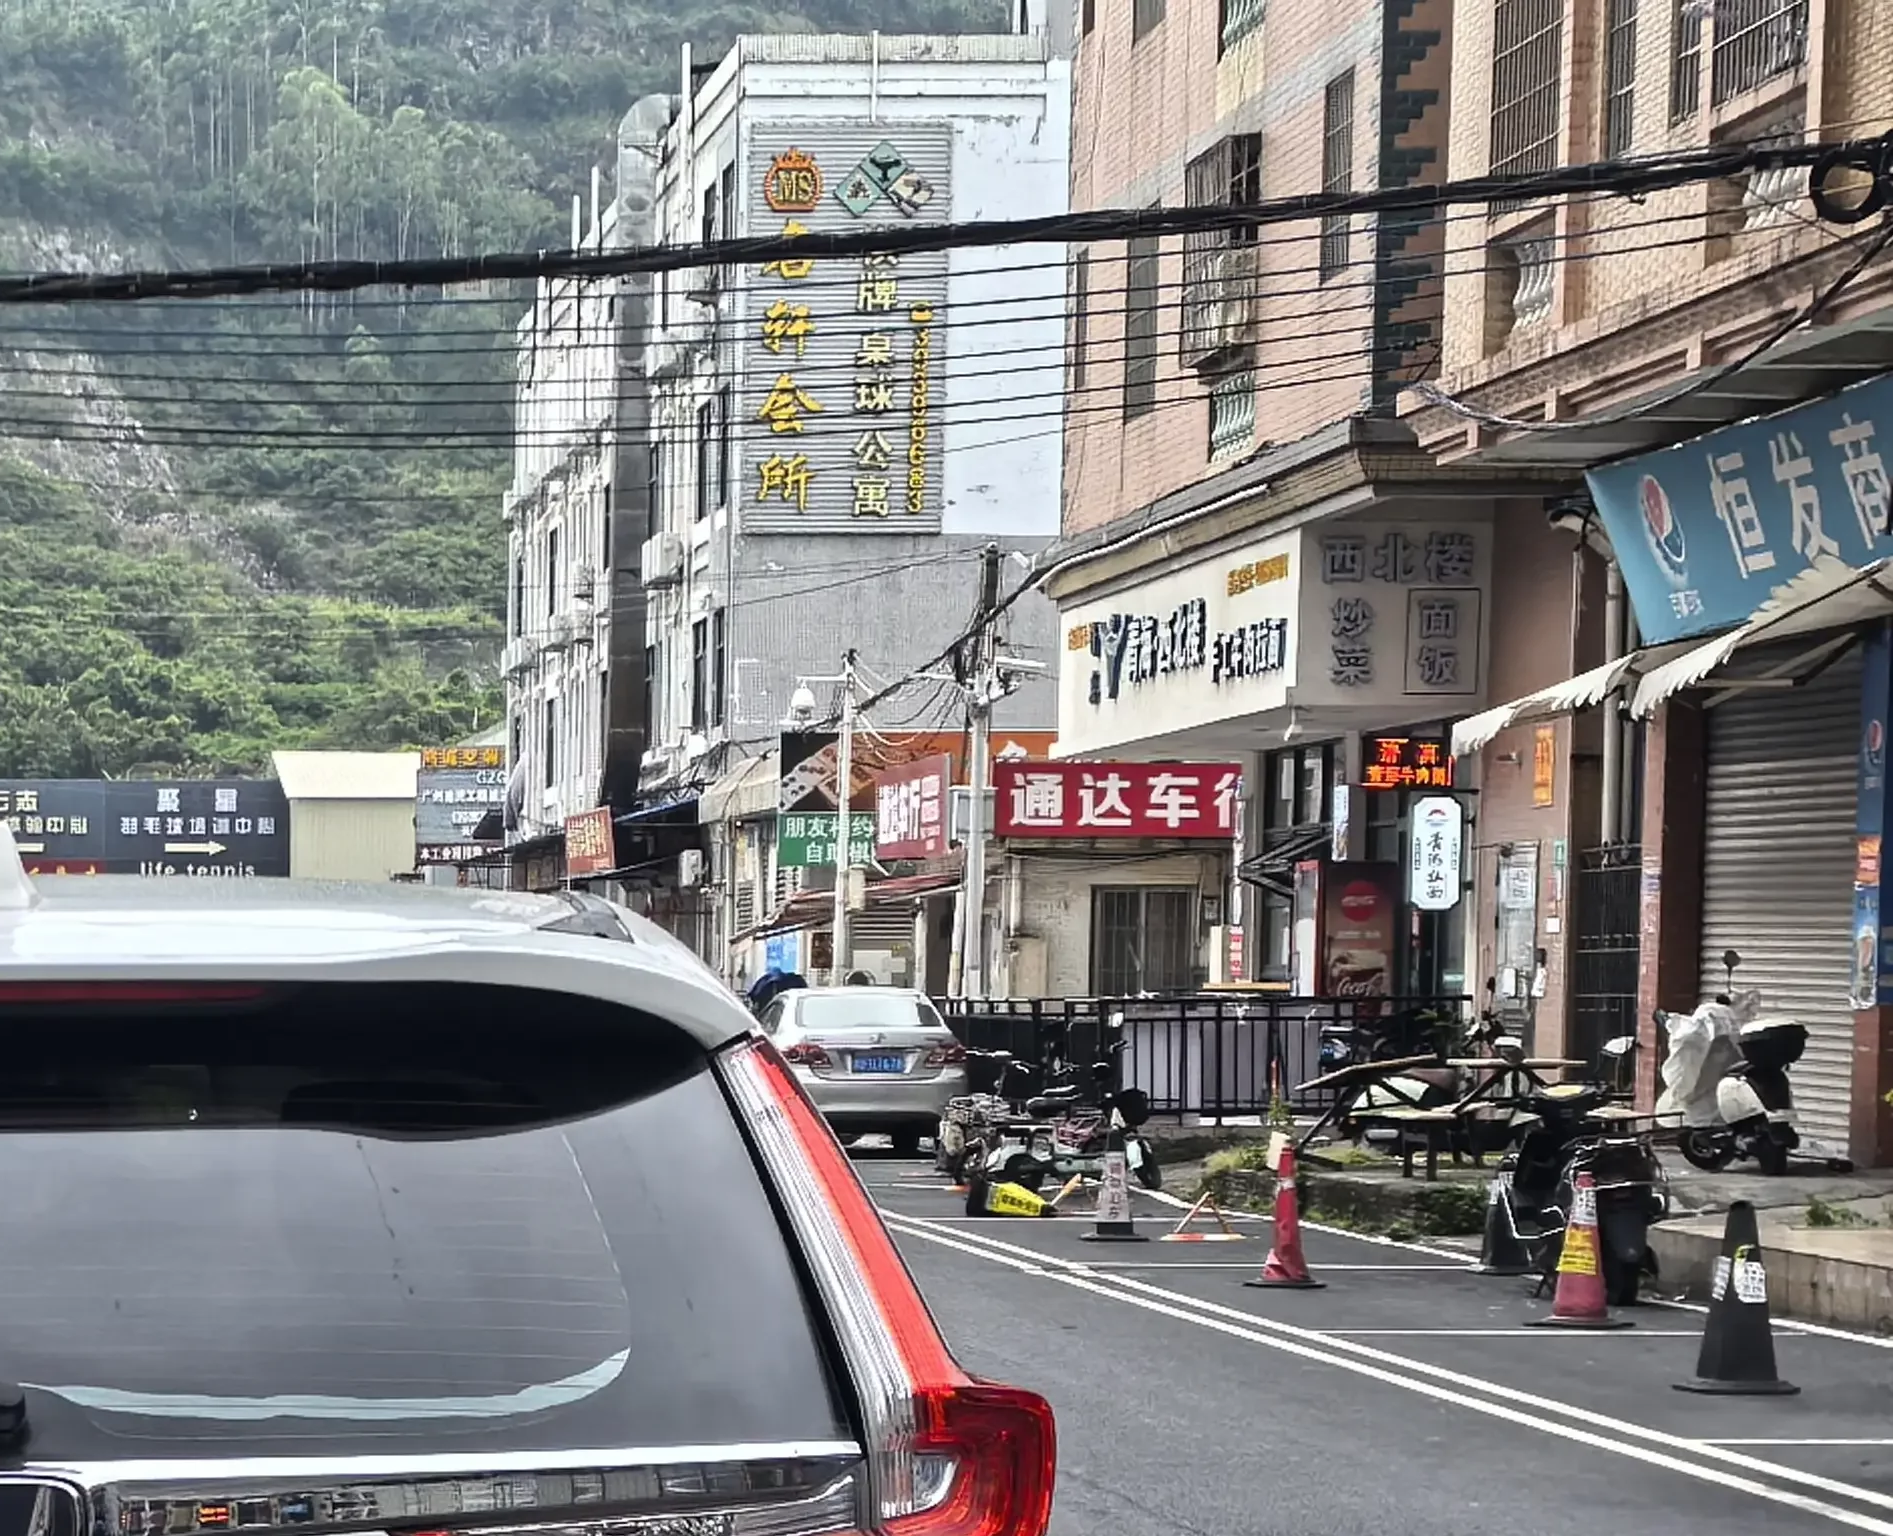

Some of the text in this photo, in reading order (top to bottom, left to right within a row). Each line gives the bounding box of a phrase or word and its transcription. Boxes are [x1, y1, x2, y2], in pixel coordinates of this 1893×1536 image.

[854, 248, 900, 517] 牌桌球公寓
[1322, 531, 1476, 584] 西北楼
[1331, 598, 1376, 686] 炒菜
[187, 862, 256, 877] tennis
